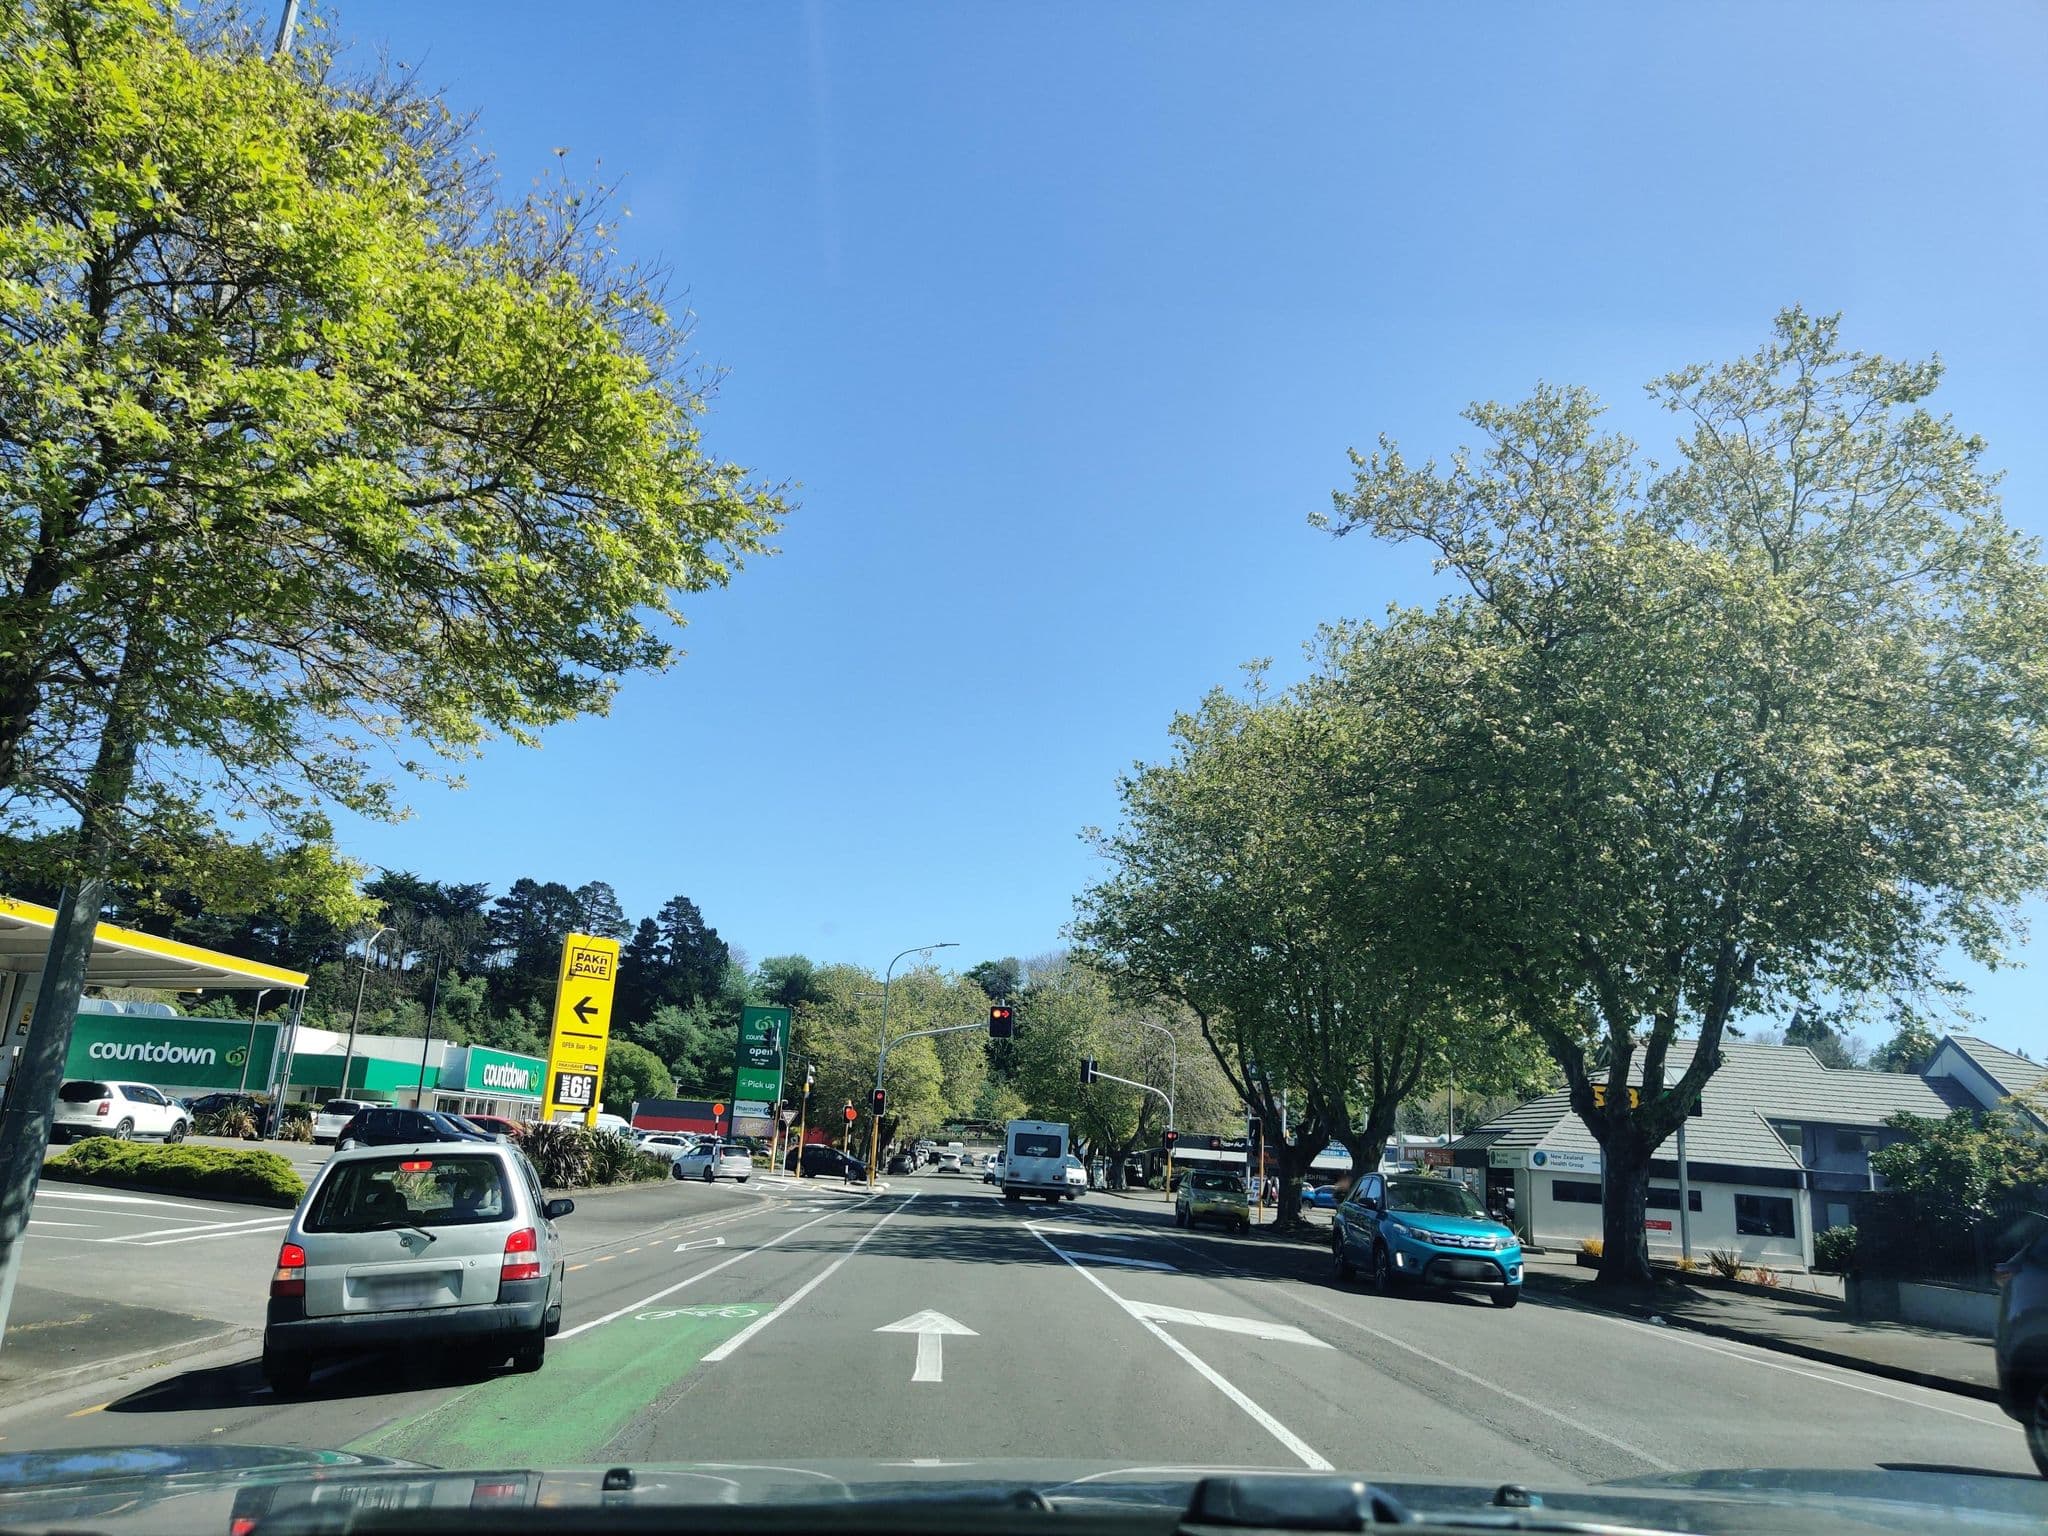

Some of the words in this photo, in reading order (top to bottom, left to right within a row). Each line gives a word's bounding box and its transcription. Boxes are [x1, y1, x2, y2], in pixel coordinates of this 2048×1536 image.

[575, 962, 606, 975] SAVE
[89, 1041, 216, 1065] countdown
[749, 1047, 773, 1057] open
[483, 1061, 529, 1090] countdown
[560, 1074, 571, 1098] SAVE
[747, 1079, 764, 1089] Pick
[765, 1081, 775, 1091] up
[735, 1105, 763, 1113] Pharmacy
[1563, 1153, 1584, 1161] Zealand
